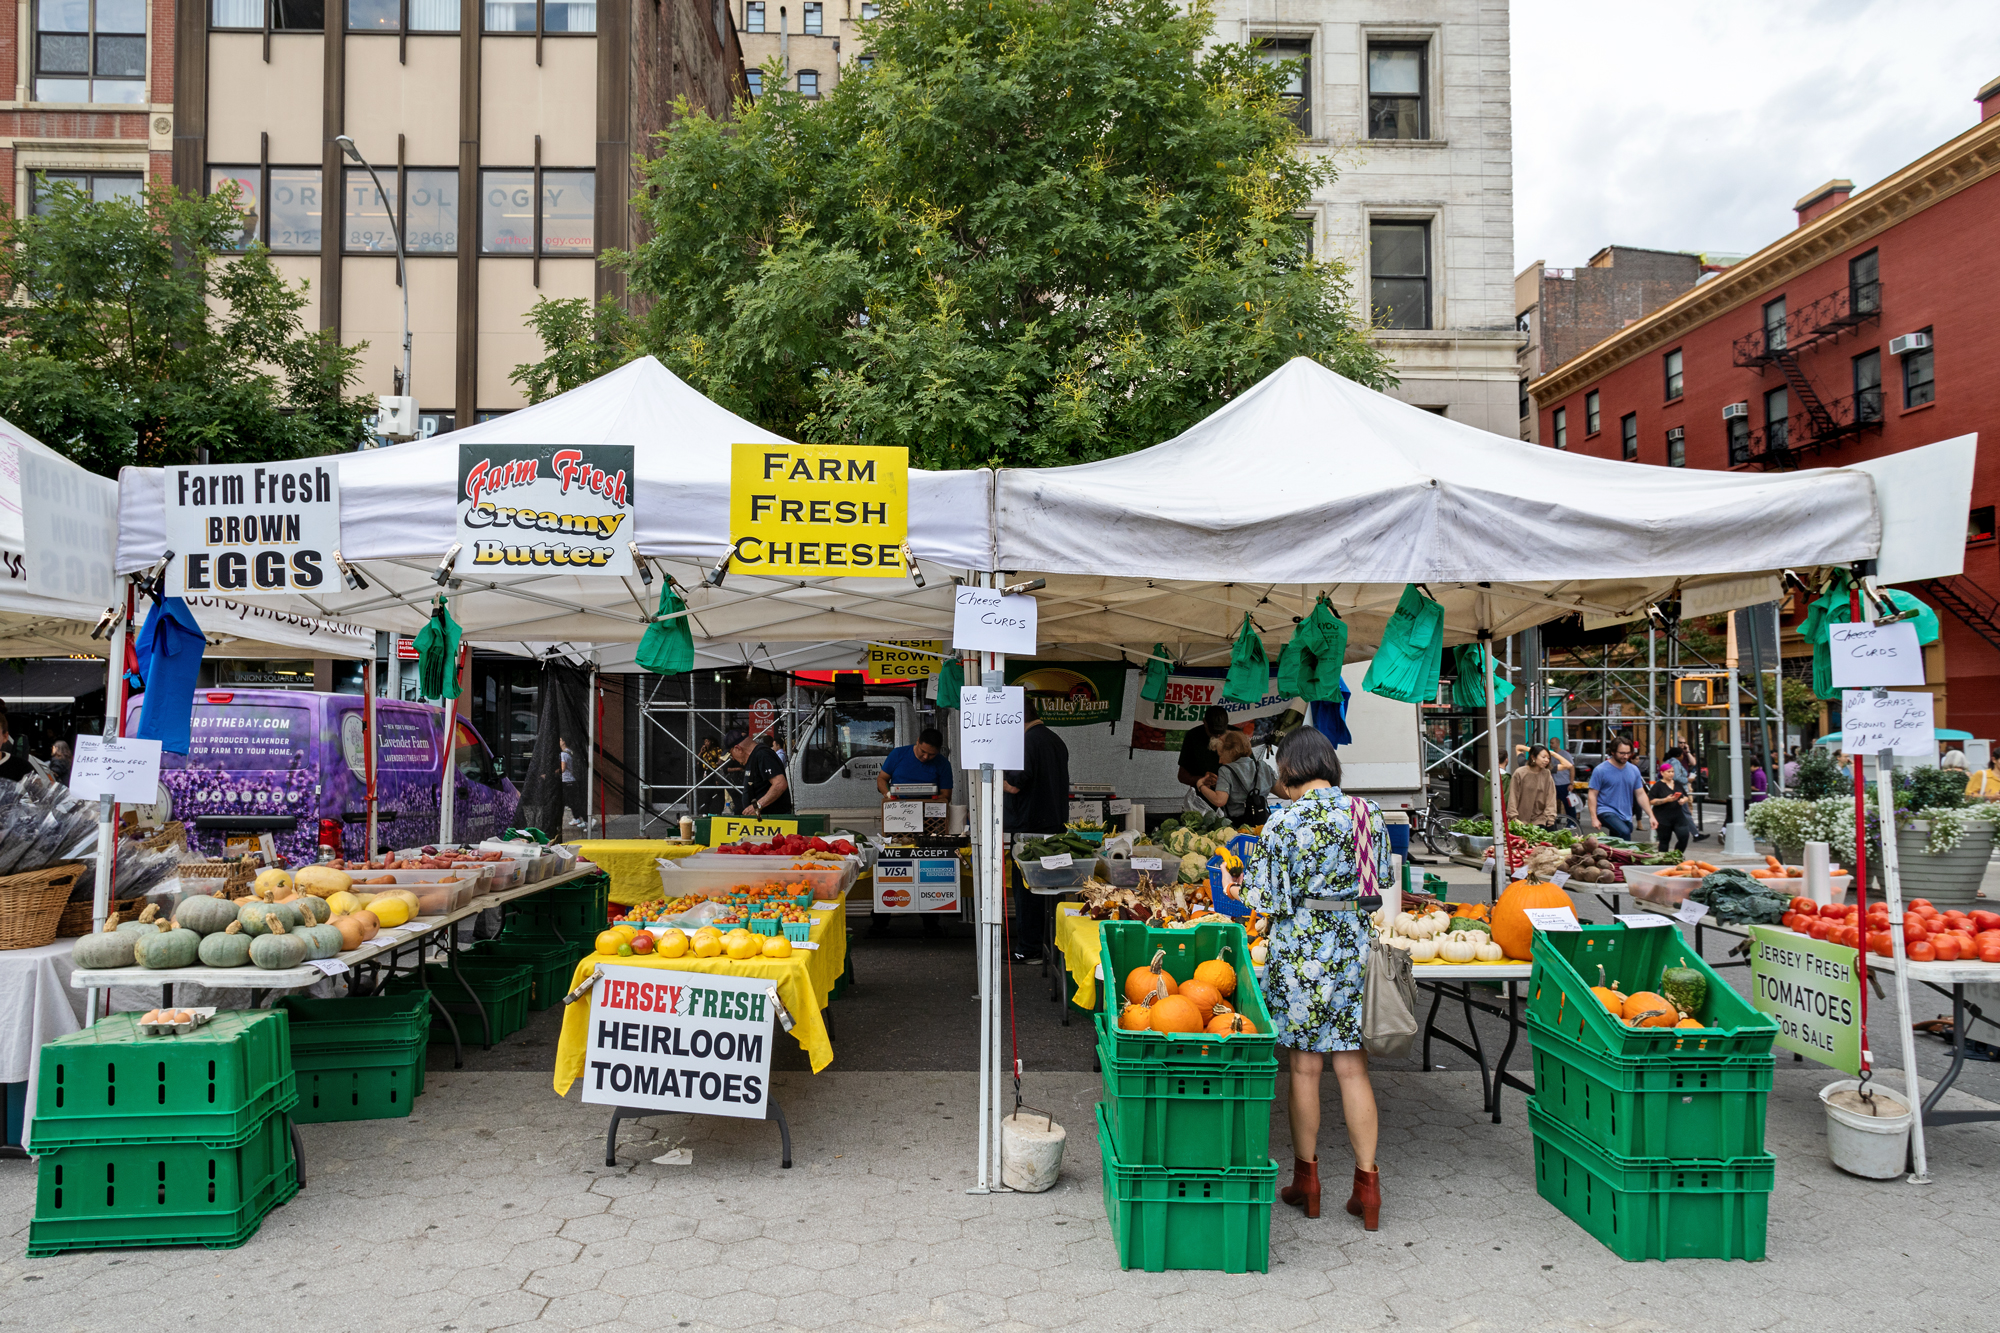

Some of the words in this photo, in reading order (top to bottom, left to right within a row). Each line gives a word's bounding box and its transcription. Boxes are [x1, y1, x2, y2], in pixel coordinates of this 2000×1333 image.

[763, 452, 878, 484] FARM
[178, 470, 244, 506] Farm
[255, 467, 330, 504] Fresh
[465, 458, 539, 511] Farm
[552, 449, 627, 509] Fresh
[751, 494, 889, 527] FRESH
[206, 514, 301, 546] BROWN
[464, 502, 627, 540] Creamy
[472, 539, 615, 568] Butter
[734, 536, 904, 571] CHEESE
[184, 550, 324, 593] EGGS
[956, 592, 1002, 608] Cheese
[981, 613, 1026, 629] CURDS
[1833, 629, 1877, 641] Cheese
[872, 650, 939, 661] BROWN
[1851, 644, 1897, 658] CURDS
[234, 674, 262, 683] UNION
[263, 675, 294, 684] SQUARE
[296, 675, 314, 683] WES
[881, 664, 930, 675] EGGS
[1165, 683, 1215, 702] ERSEY
[1042, 698, 1077, 715] Valley
[1080, 700, 1109, 711] Farm
[1874, 698, 1914, 708] GRASS
[963, 711, 992, 730] BLUE
[995, 711, 1023, 726] EGGS
[1845, 719, 1886, 730] GROUND
[251, 737, 290, 745] LAVENDER
[378, 734, 410, 748] Lavender
[411, 735, 430, 749] Farm
[246, 747, 266, 755] YOUR
[269, 748, 293, 756] HOME.
[726, 822, 782, 836] FARM
[884, 849, 901, 857] WE
[910, 849, 948, 857] ACCEPT
[884, 867, 908, 876] VISA
[1758, 941, 1801, 969] JERSEY
[1807, 952, 1850, 983] FRESH
[601, 979, 683, 1014] JERSEY
[688, 987, 767, 1022] FRESH
[1757, 973, 1853, 1026] TOMATOES
[597, 1020, 763, 1064] HEIRLOOM
[1802, 1023, 1834, 1053] SALE
[591, 1060, 762, 1105] TOMATOES
